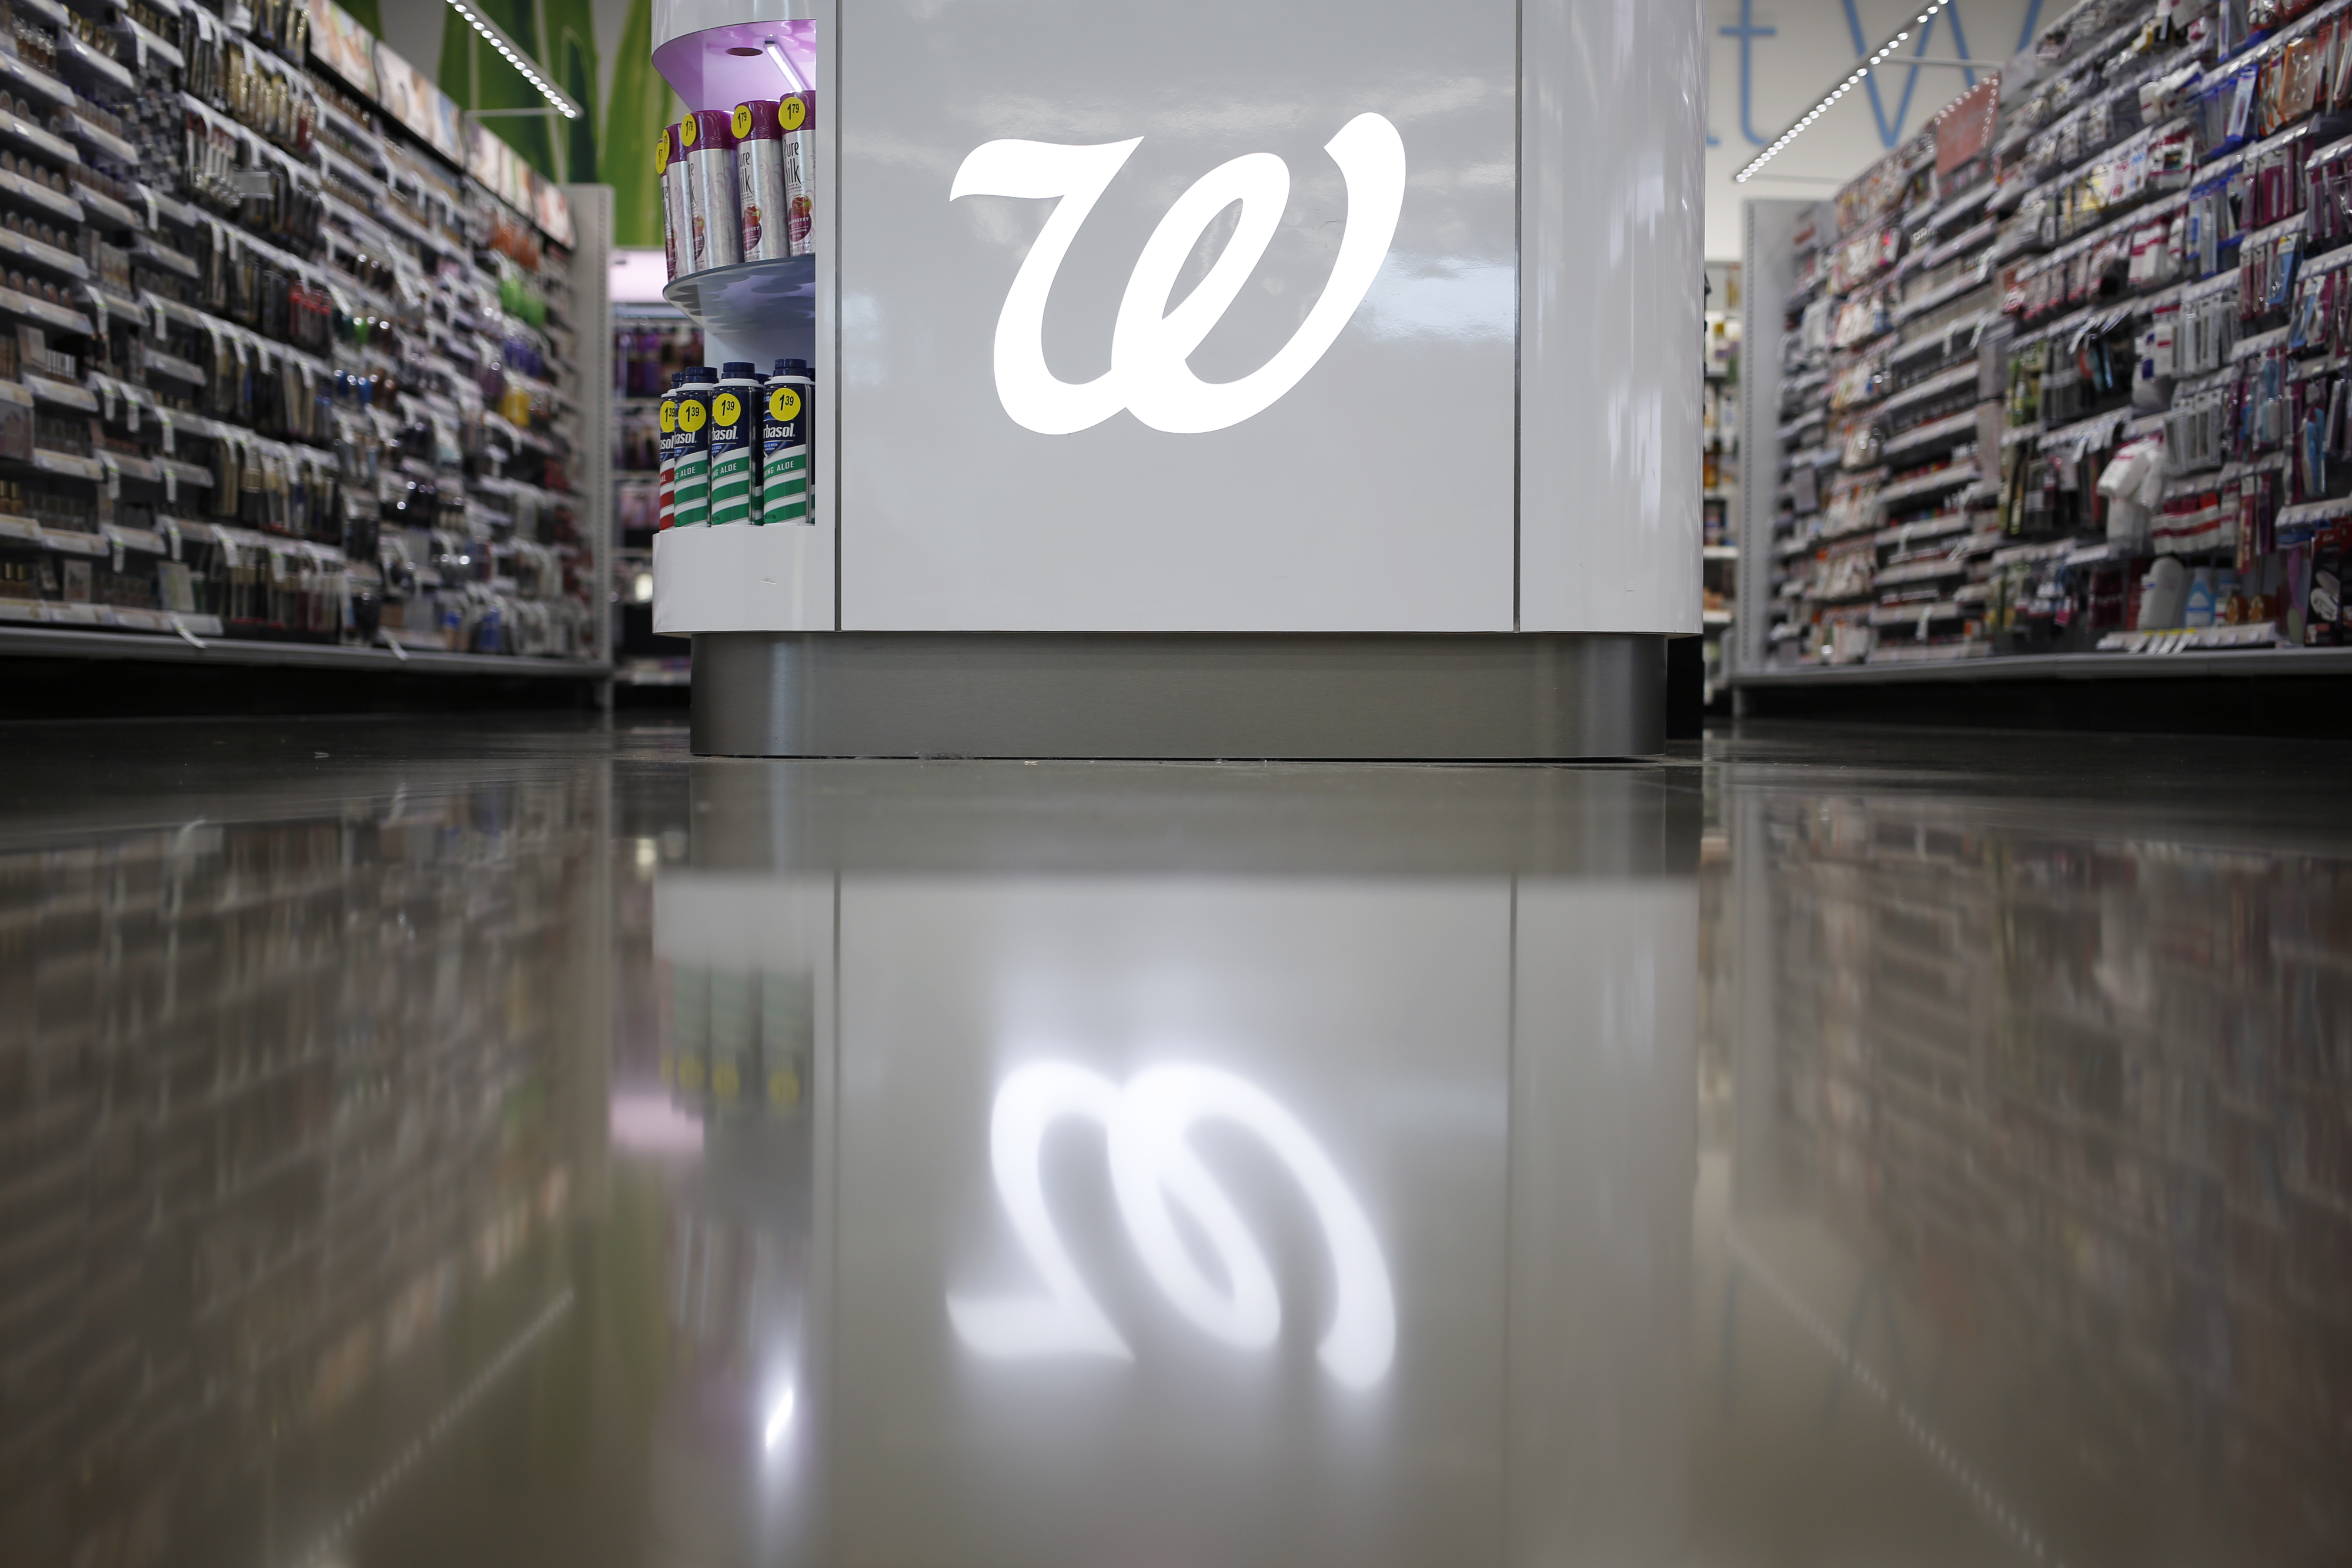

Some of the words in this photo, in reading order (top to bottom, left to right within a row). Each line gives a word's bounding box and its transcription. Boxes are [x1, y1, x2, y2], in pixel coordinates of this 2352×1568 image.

[680, 466, 696, 477] ALOE
[720, 463, 737, 474] ALOE
[777, 460, 794, 472] ALOE
